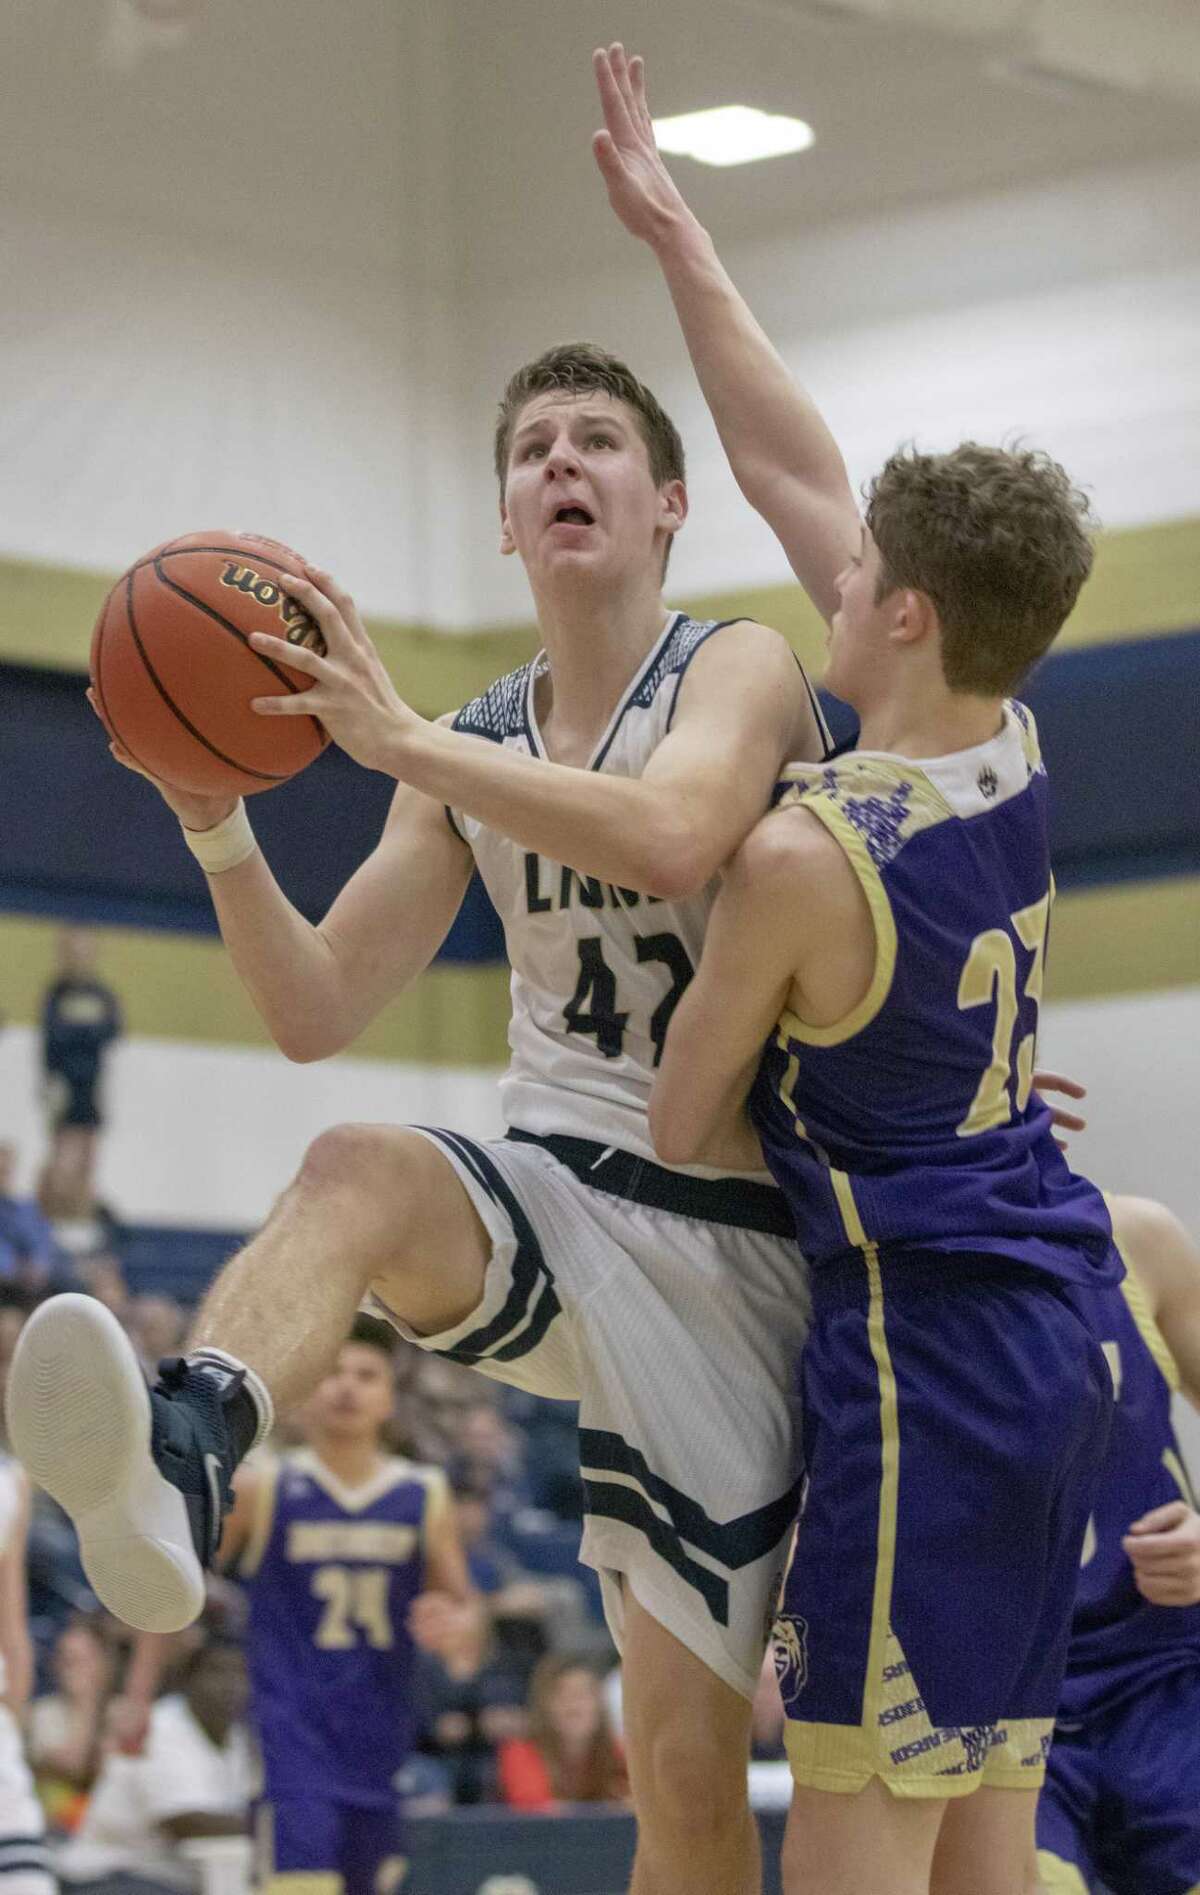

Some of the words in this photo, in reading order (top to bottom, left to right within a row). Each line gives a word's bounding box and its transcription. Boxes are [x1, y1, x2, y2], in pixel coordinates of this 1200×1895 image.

[219, 559, 328, 658] lson
[563, 933, 696, 1068] 42
[311, 1565, 392, 1650] 24
